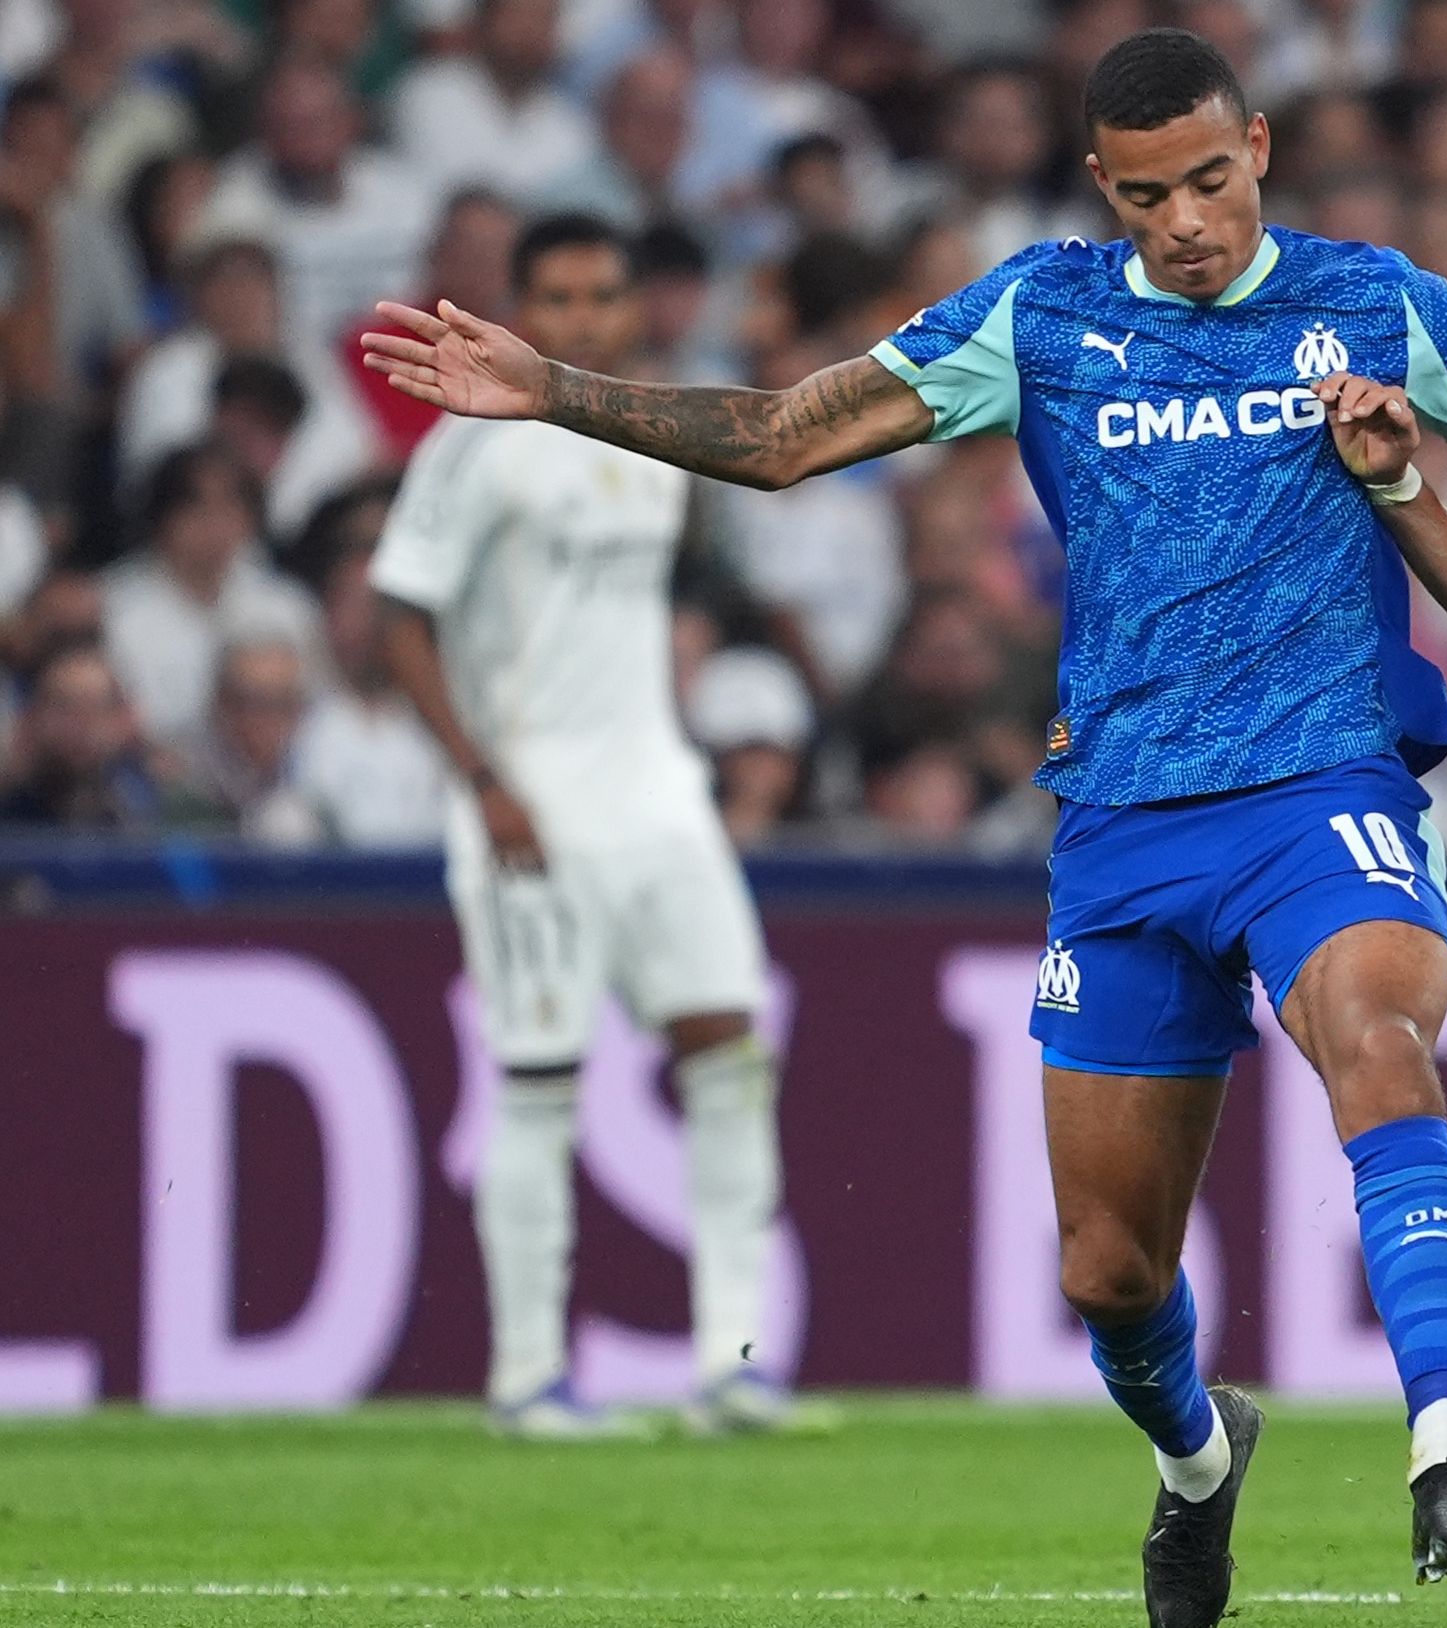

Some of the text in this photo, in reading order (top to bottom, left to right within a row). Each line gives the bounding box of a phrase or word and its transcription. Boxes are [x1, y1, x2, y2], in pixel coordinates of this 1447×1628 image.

[1097, 387, 1343, 448] CMA CG
[1328, 812, 1415, 872] 10
[0, 945, 808, 1406] D'S
